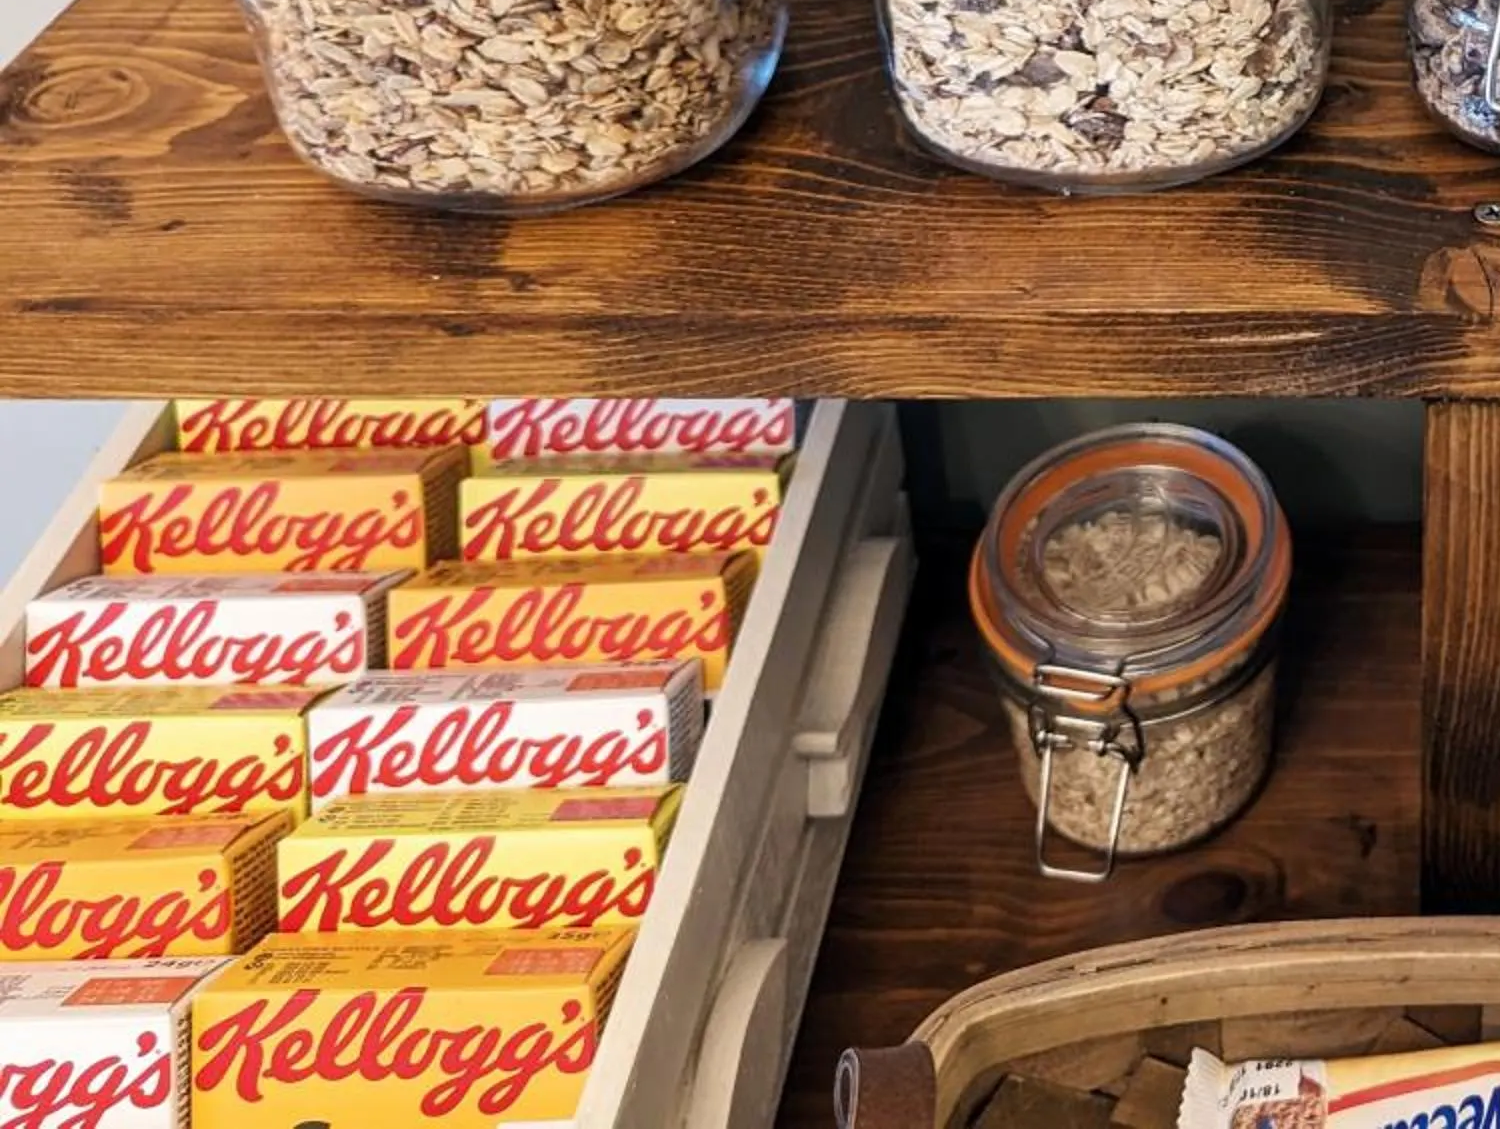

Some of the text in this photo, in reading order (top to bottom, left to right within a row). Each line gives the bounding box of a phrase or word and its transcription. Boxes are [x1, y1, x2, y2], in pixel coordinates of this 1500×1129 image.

[100, 481, 423, 574] Kellogg's
[460, 477, 780, 563] Kellogg's
[27, 601, 365, 689] Kellogg's
[394, 582, 731, 671] Kellogg's
[311, 705, 668, 793] Kellogg's
[279, 837, 657, 931] Kellogg's
[195, 986, 601, 1118] Kellogg's
